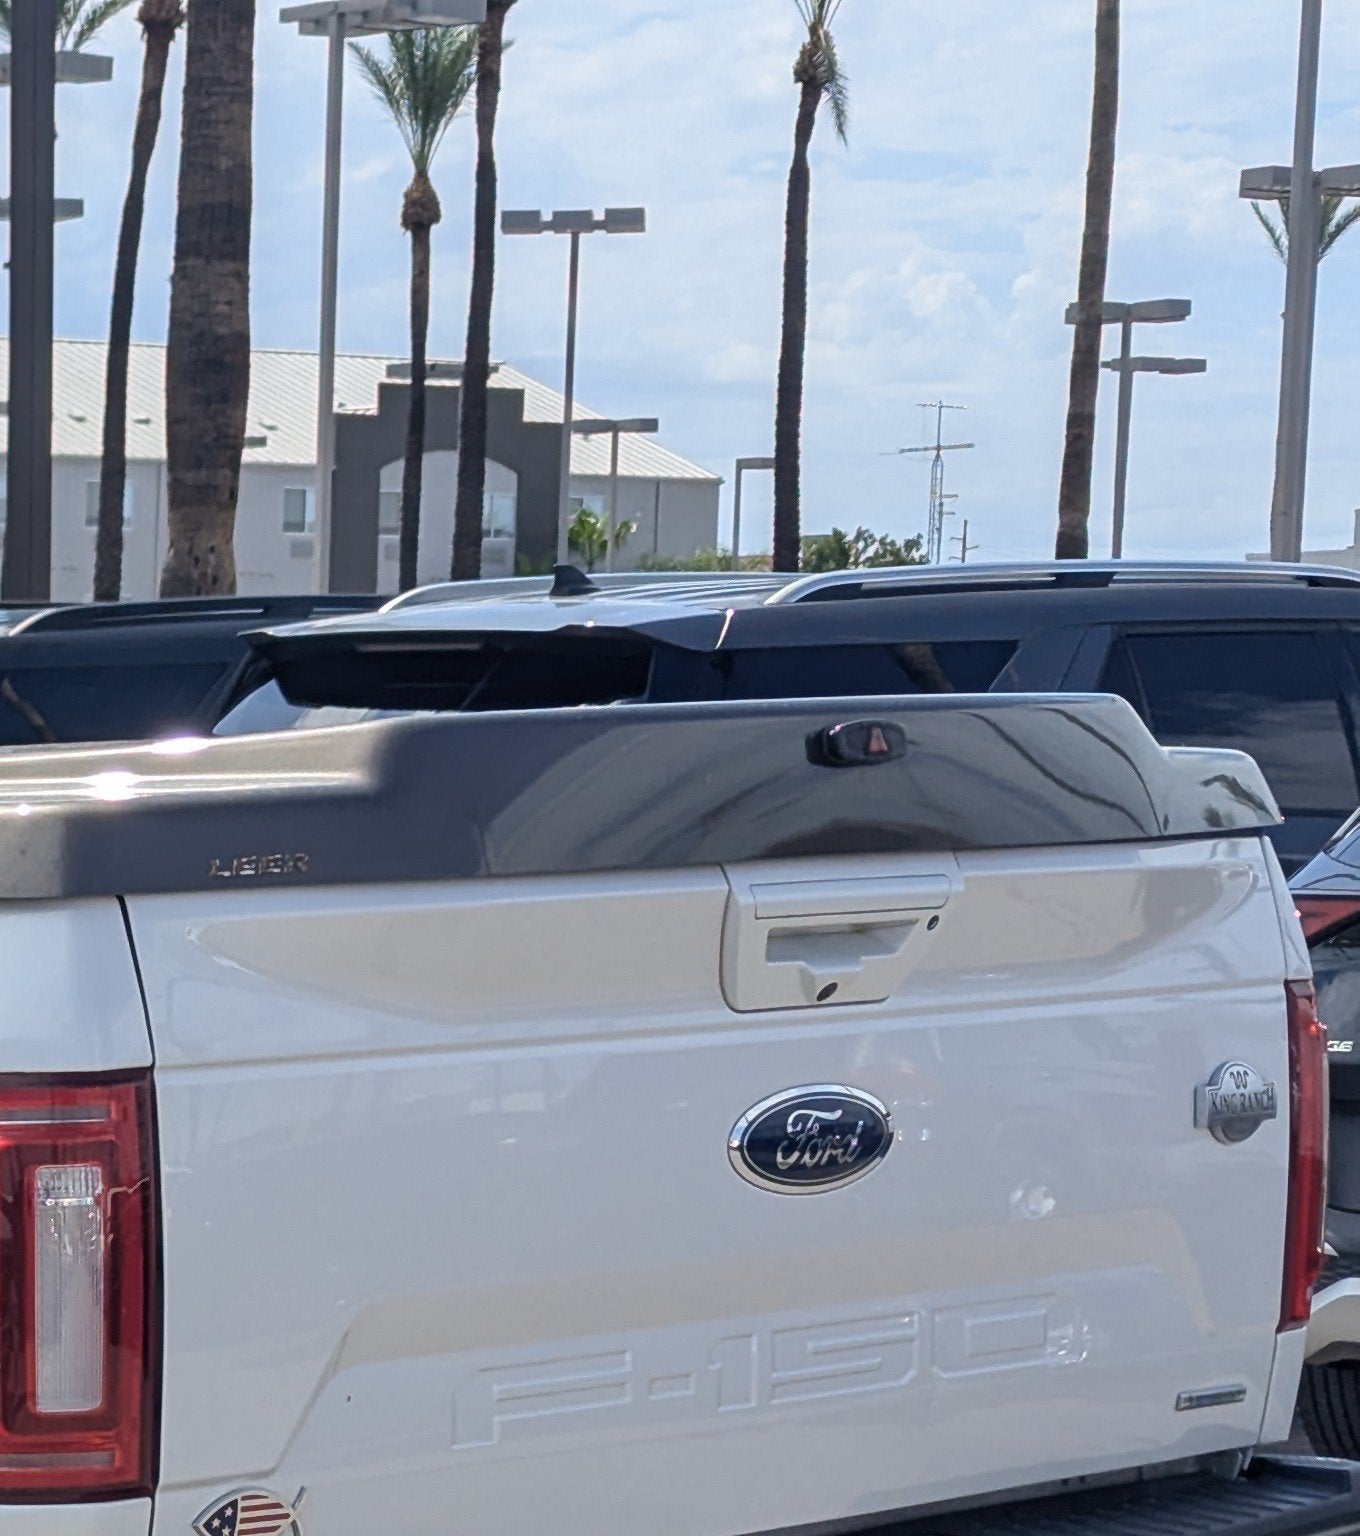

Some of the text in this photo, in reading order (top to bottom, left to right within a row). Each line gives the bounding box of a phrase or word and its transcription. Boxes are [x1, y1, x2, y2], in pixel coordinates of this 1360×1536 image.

[208, 852, 309, 877] LEER
[1209, 1086, 1274, 1115] KING RANCH
[776, 1109, 864, 1170] Ford
[451, 1292, 1086, 1451] F-150
